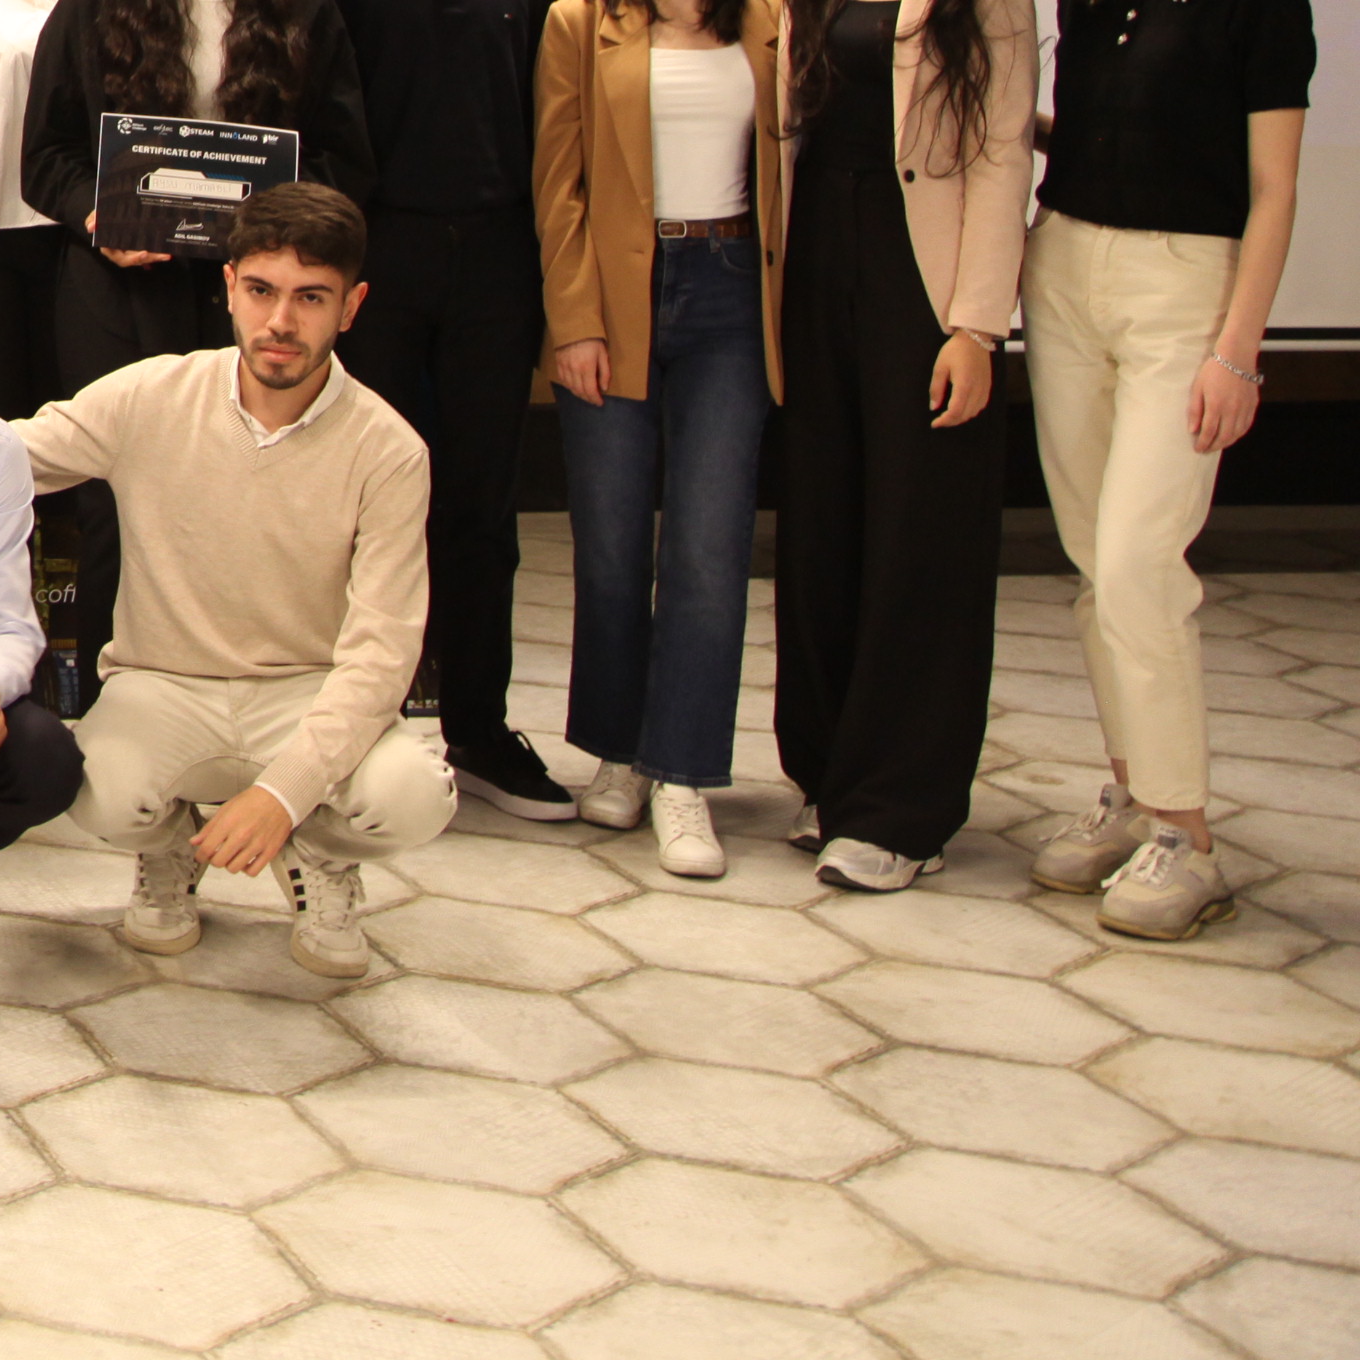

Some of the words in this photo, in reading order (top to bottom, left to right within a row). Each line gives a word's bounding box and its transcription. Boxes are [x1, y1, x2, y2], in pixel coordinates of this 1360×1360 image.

[220, 132, 257, 142] INNOLAND
[132, 145, 188, 157] CERTIFICATE
[189, 150, 202, 158] OF
[203, 151, 267, 164] ACHIEVEMENT
